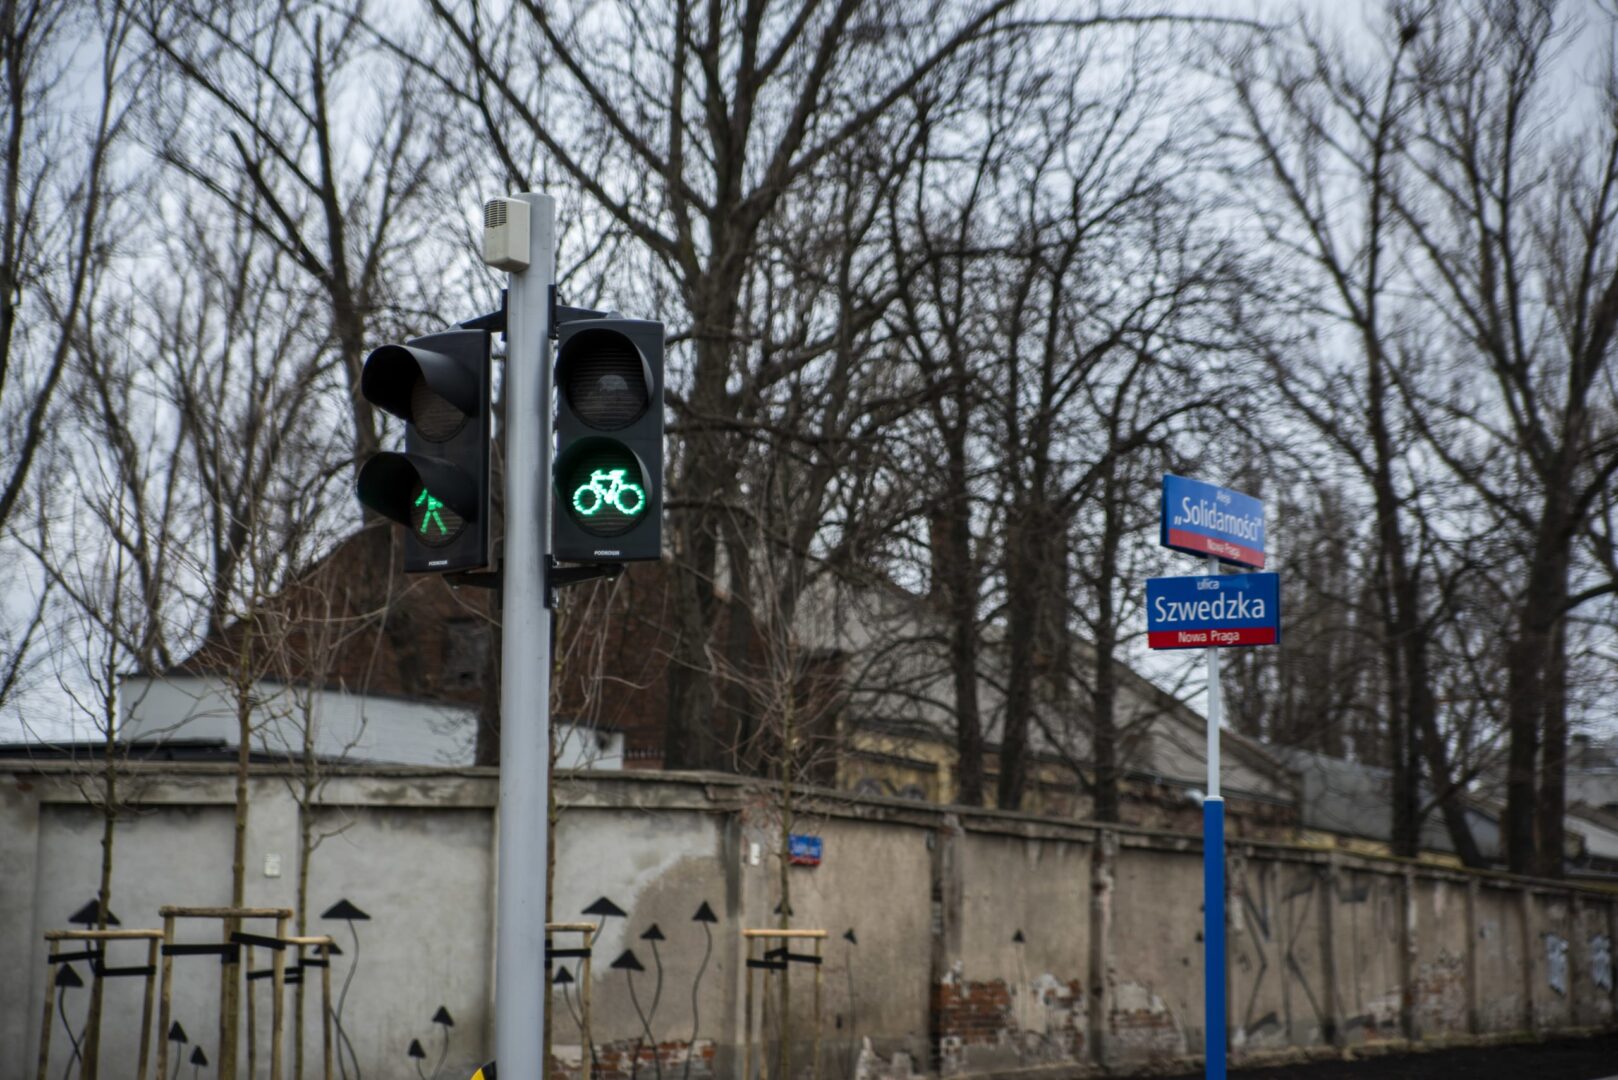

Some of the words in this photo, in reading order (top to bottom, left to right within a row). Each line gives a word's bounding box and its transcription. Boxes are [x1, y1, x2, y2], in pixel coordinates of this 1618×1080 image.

[1197, 578, 1219, 590] ulica
[1155, 591, 1265, 622] Szwedzka
[1178, 631, 1207, 643] Nowa
[1211, 630, 1240, 644] Praga
